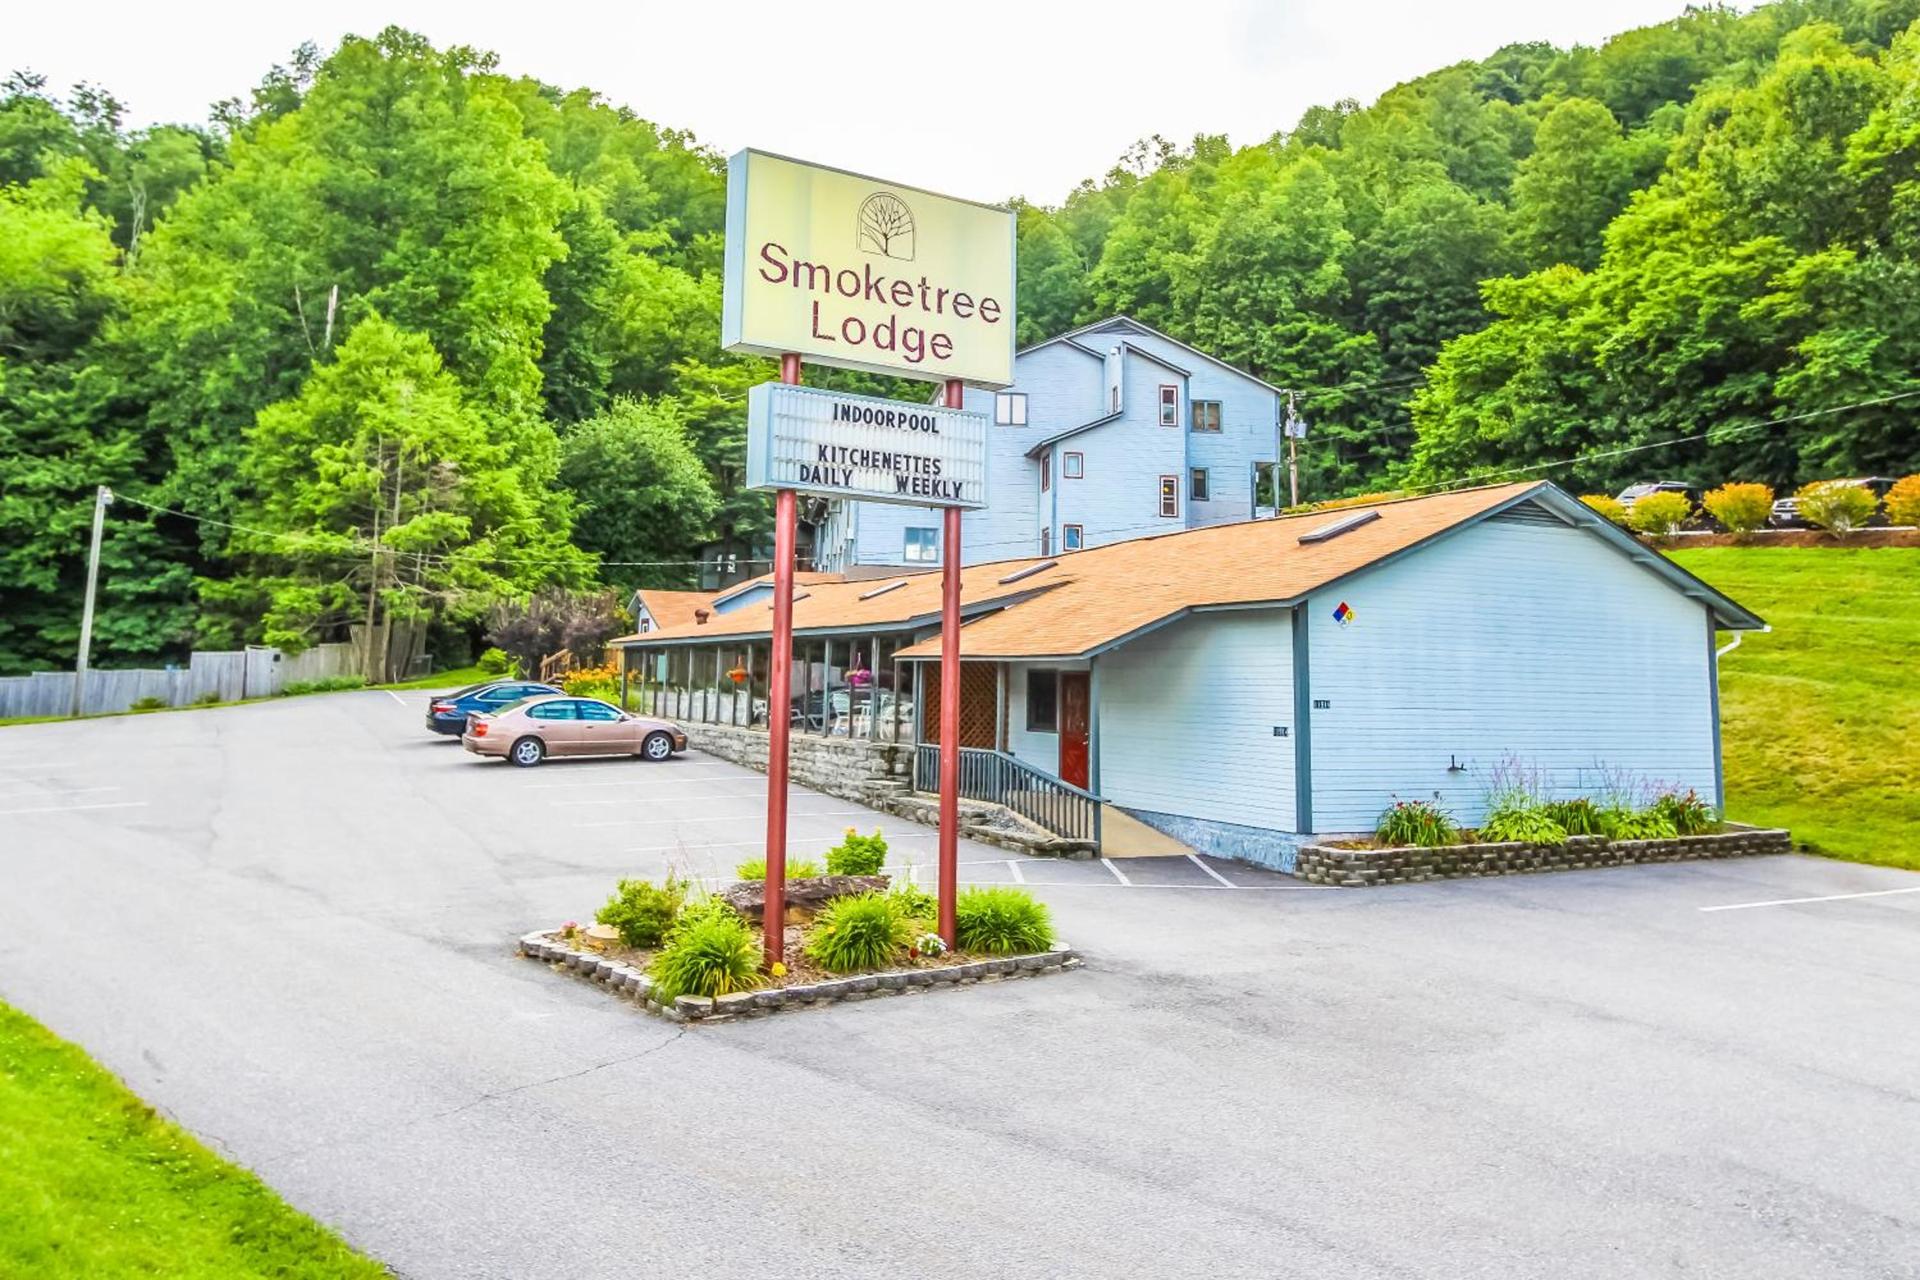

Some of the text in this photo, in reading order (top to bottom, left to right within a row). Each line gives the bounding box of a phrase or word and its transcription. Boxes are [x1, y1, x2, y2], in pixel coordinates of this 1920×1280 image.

[759, 242, 1001, 323] Smoketree
[812, 301, 953, 363] Lodge
[800, 464, 963, 498] DAILY WEEKLY
[818, 444, 942, 475] KITCHENETTES
